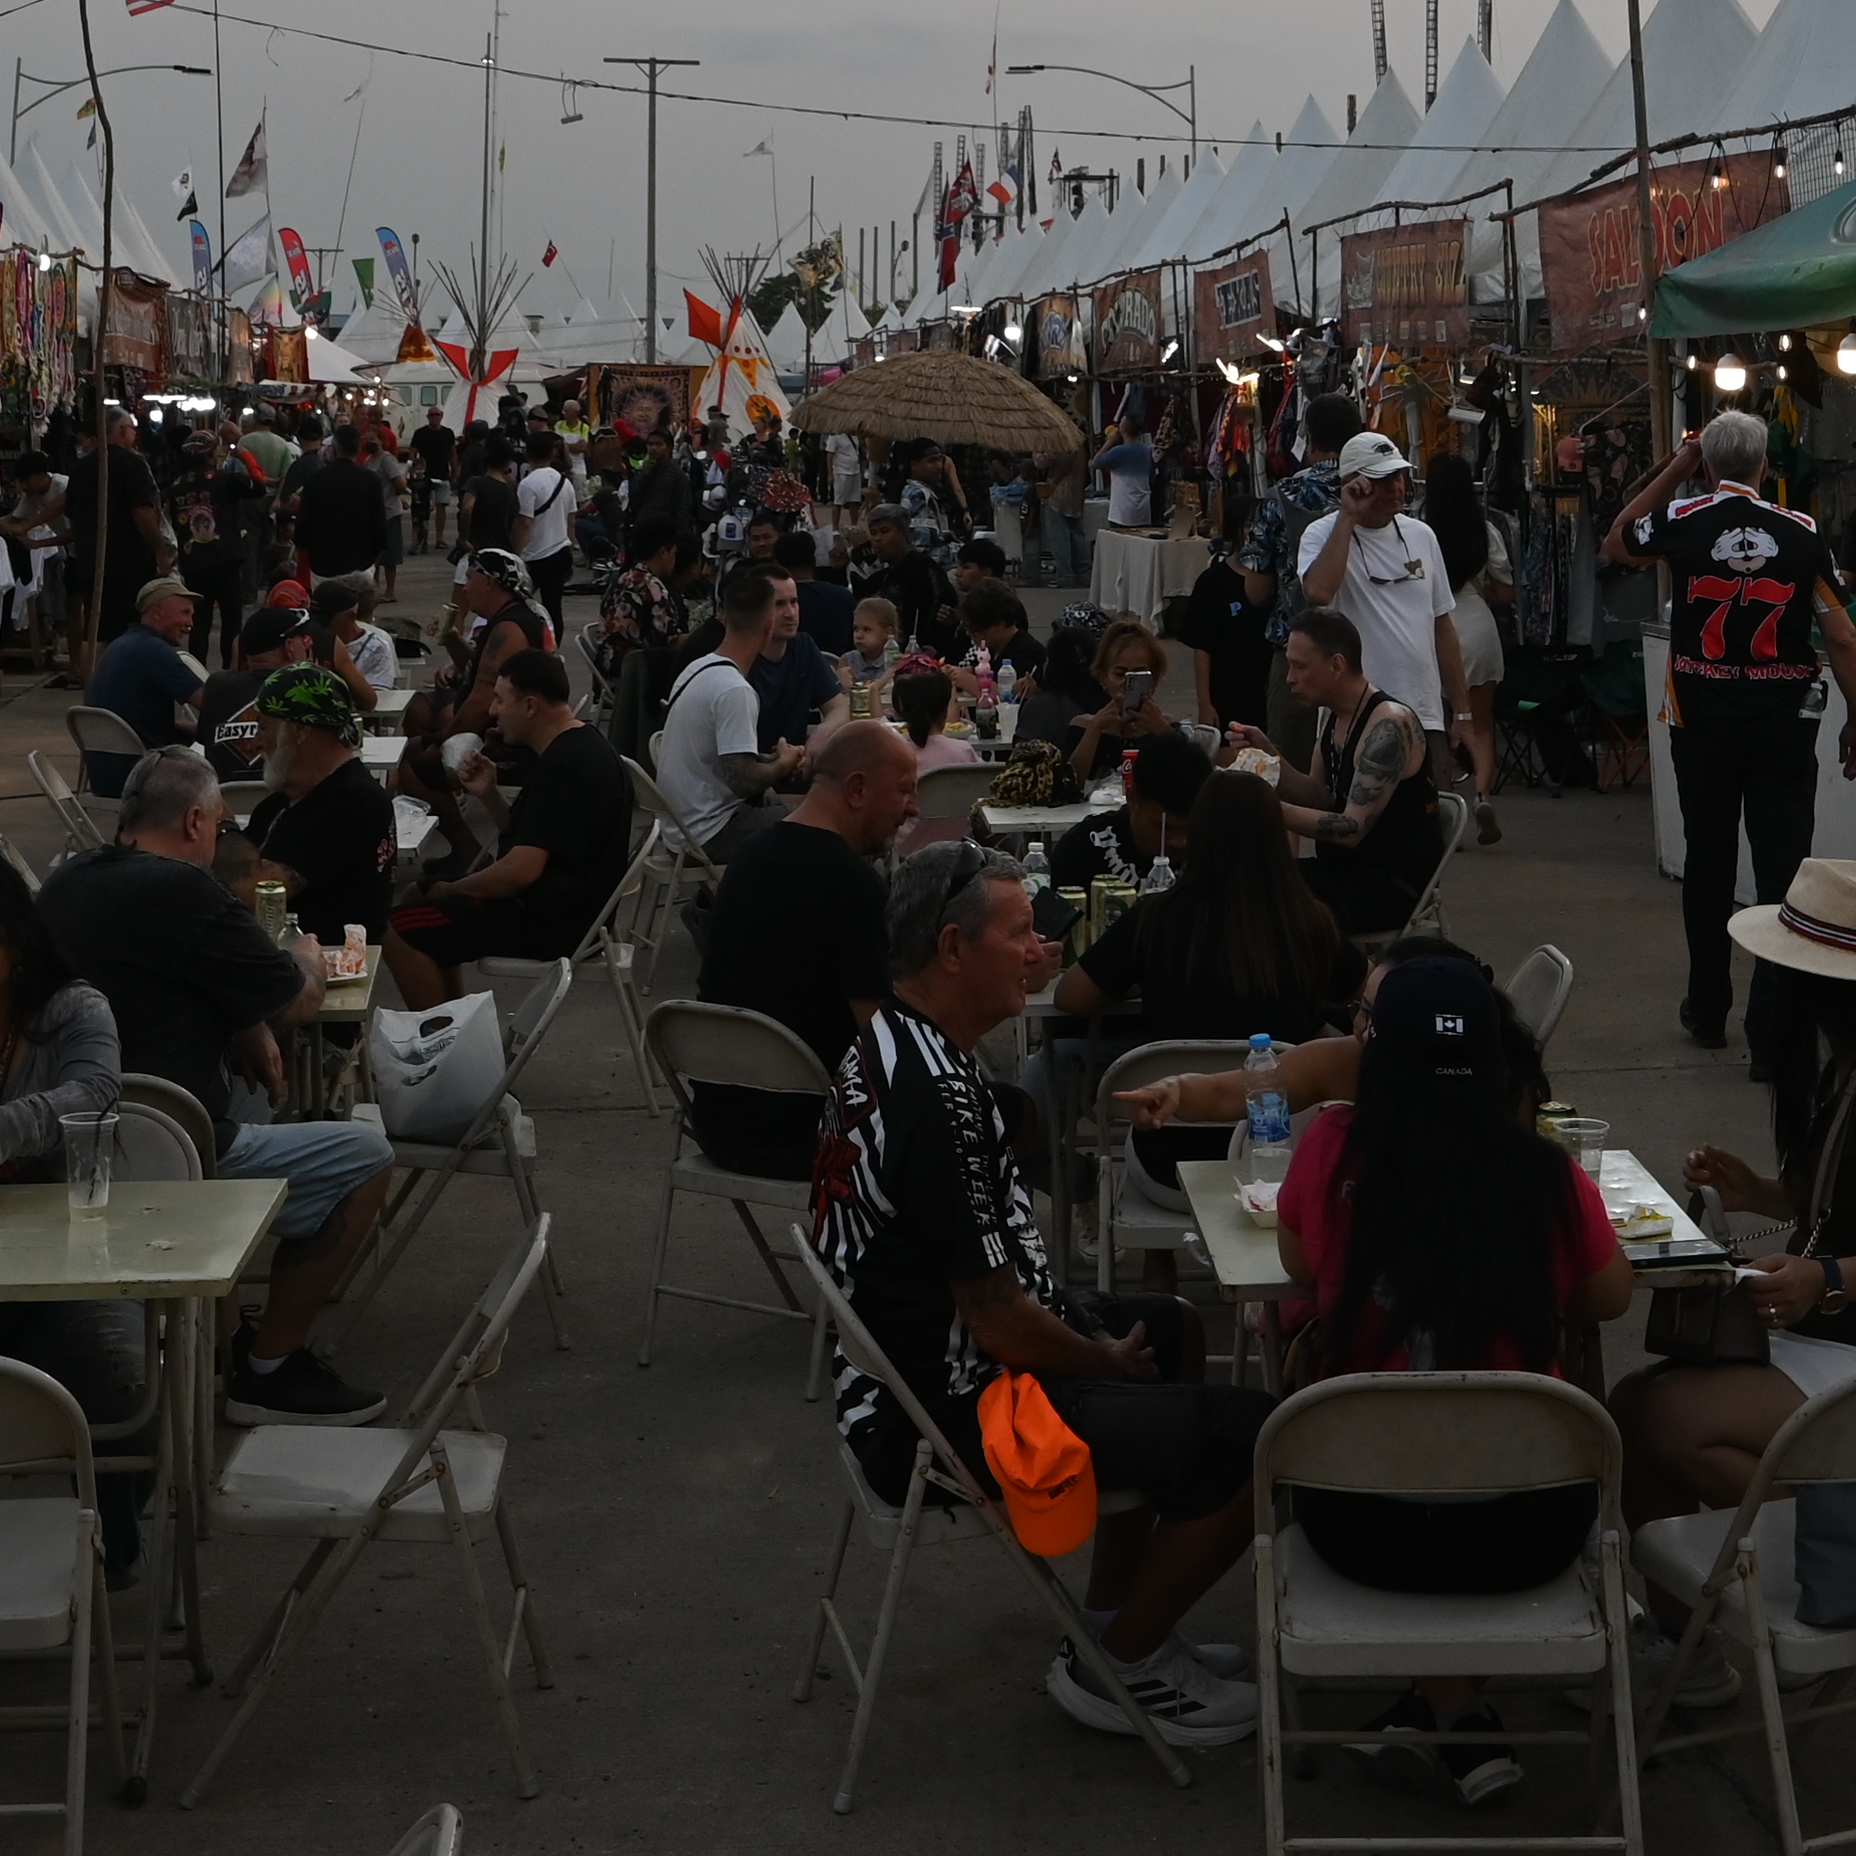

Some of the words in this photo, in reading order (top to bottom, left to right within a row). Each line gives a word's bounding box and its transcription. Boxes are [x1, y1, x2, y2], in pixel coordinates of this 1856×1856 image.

[1587, 188, 1726, 298] SALOON
[1687, 574, 1796, 662] 77
[1674, 653, 1741, 680] MICKEY
[217, 724, 257, 739] Easyr
[1435, 1067, 1473, 1077] CANADA
[936, 1082, 955, 1111] FEB
[946, 1076, 980, 1144] BIKE
[966, 1155, 993, 1227] WEEK
